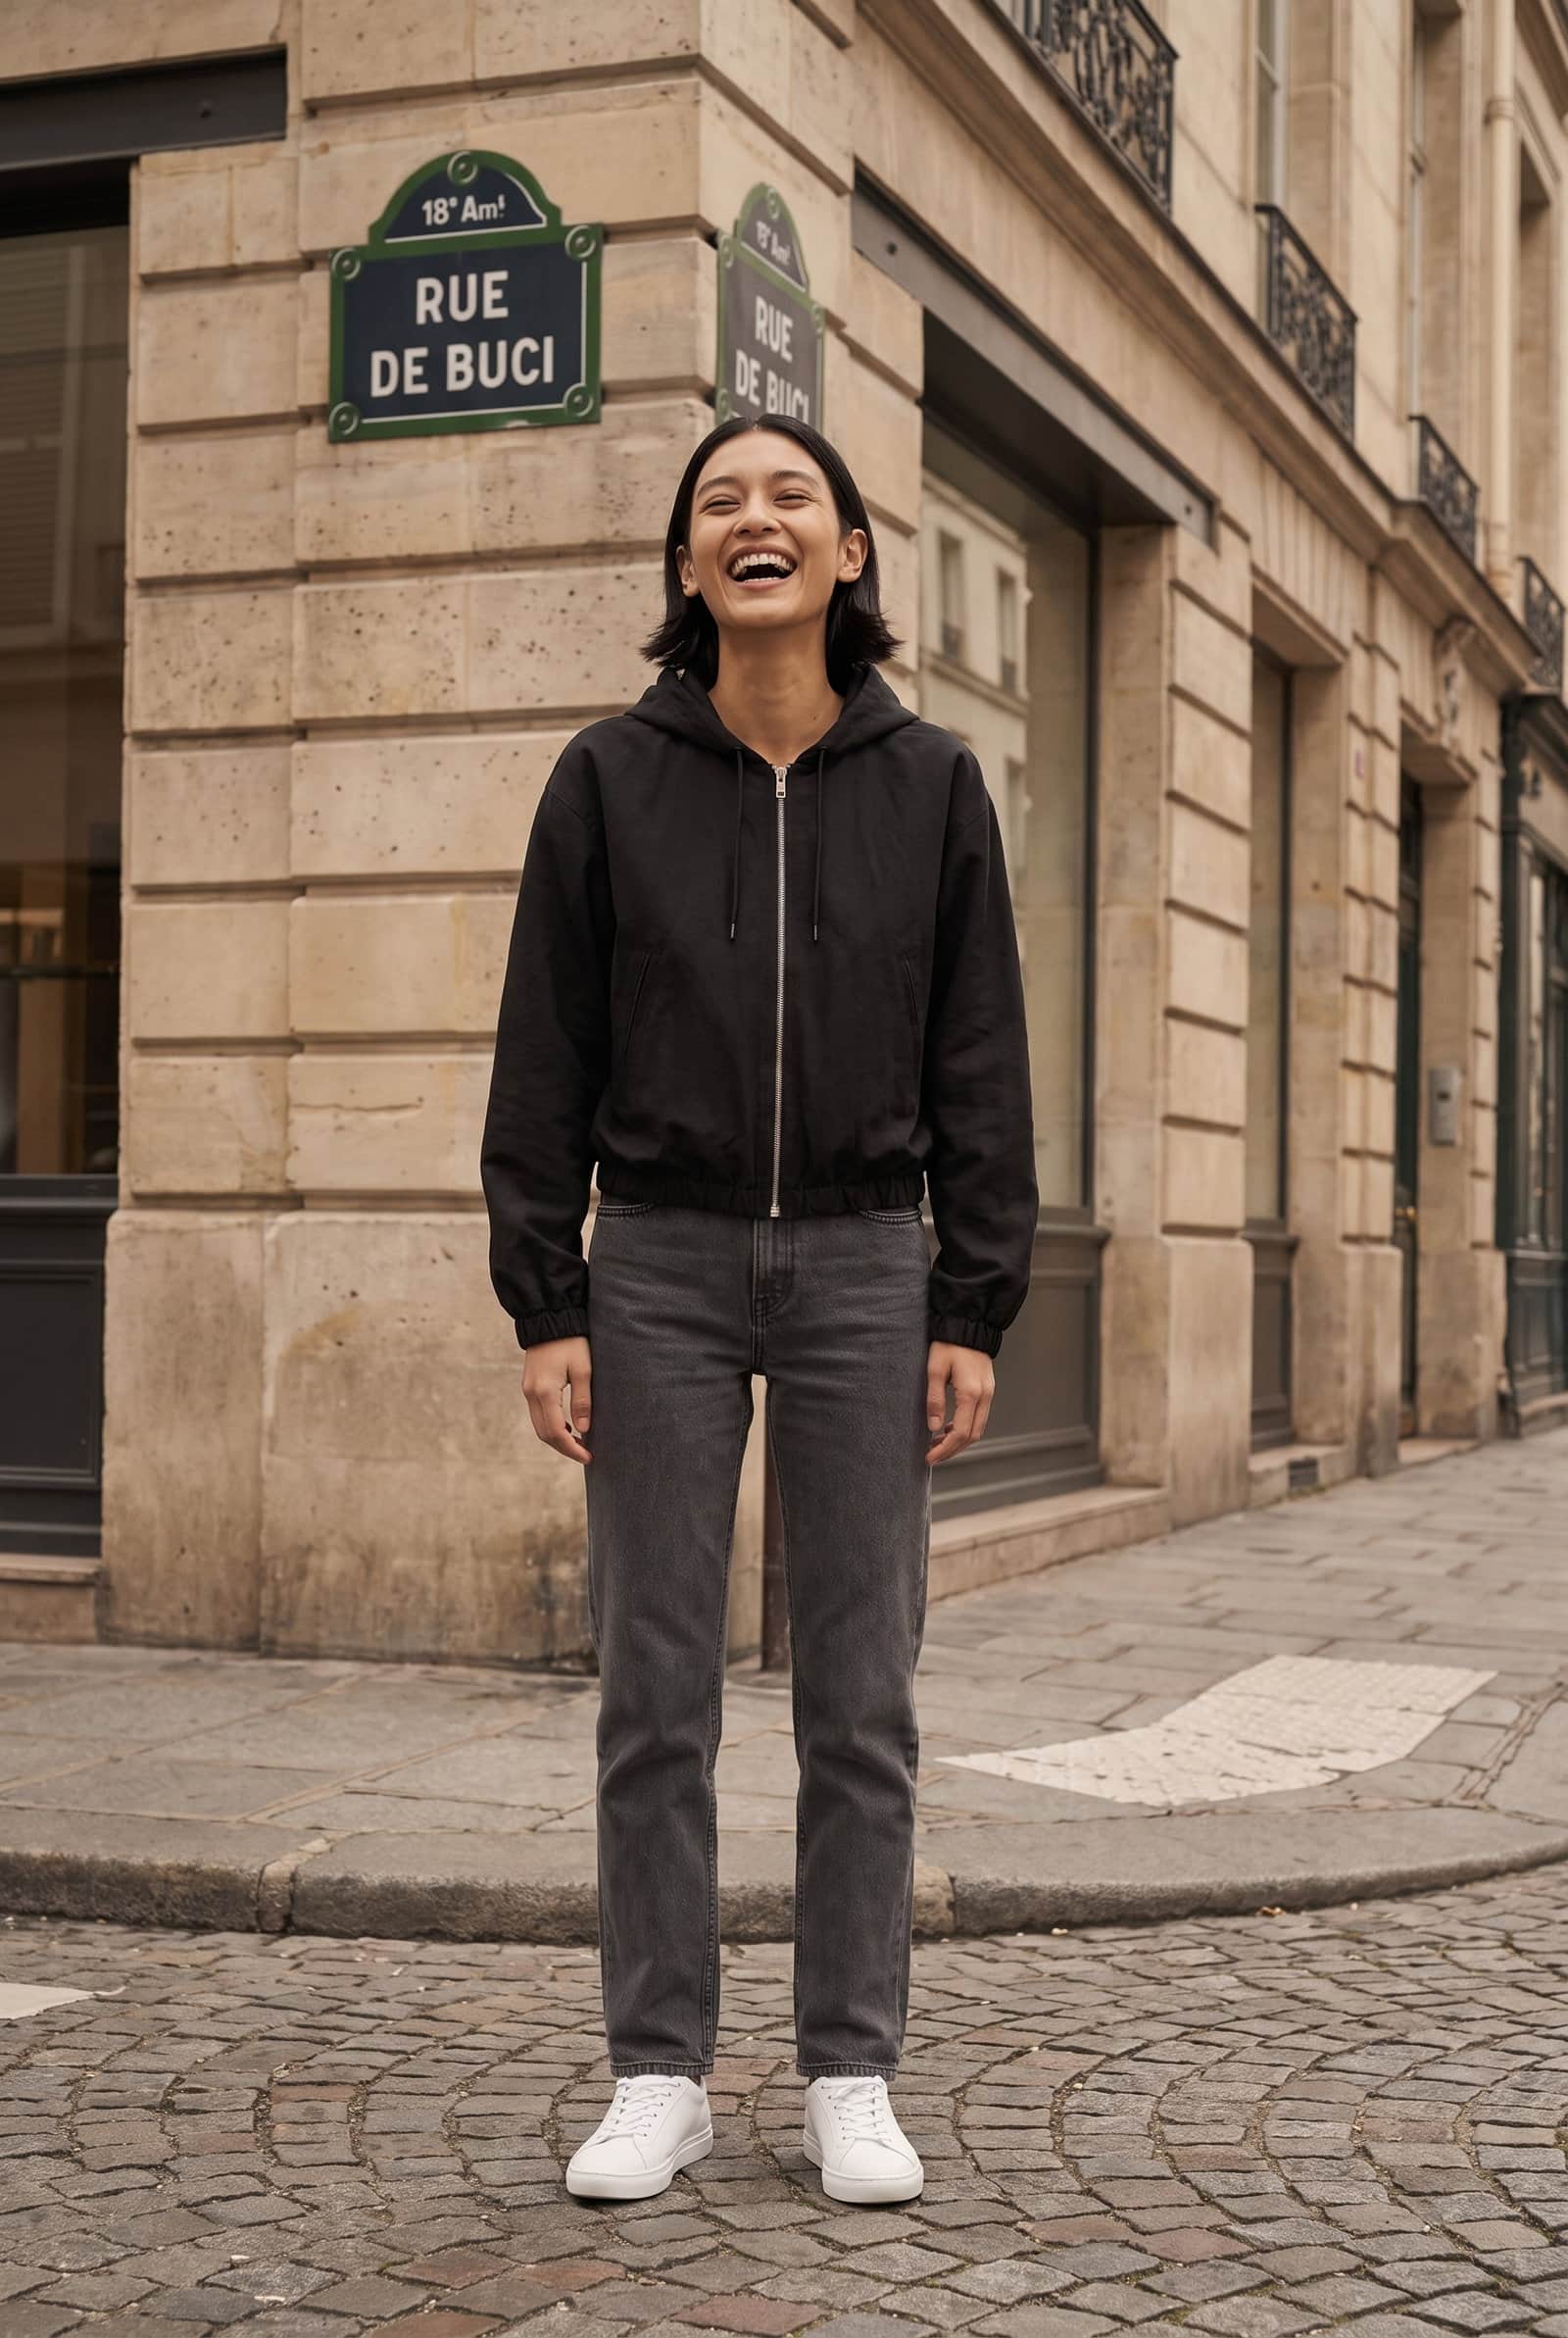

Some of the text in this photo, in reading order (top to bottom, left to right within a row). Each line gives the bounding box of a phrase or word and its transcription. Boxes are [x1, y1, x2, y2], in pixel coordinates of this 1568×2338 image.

[416, 270, 510, 325] RUE
[755, 295, 793, 363] RUE
[369, 335, 554, 398] DE BUCI
[735, 348, 761, 408] DE
